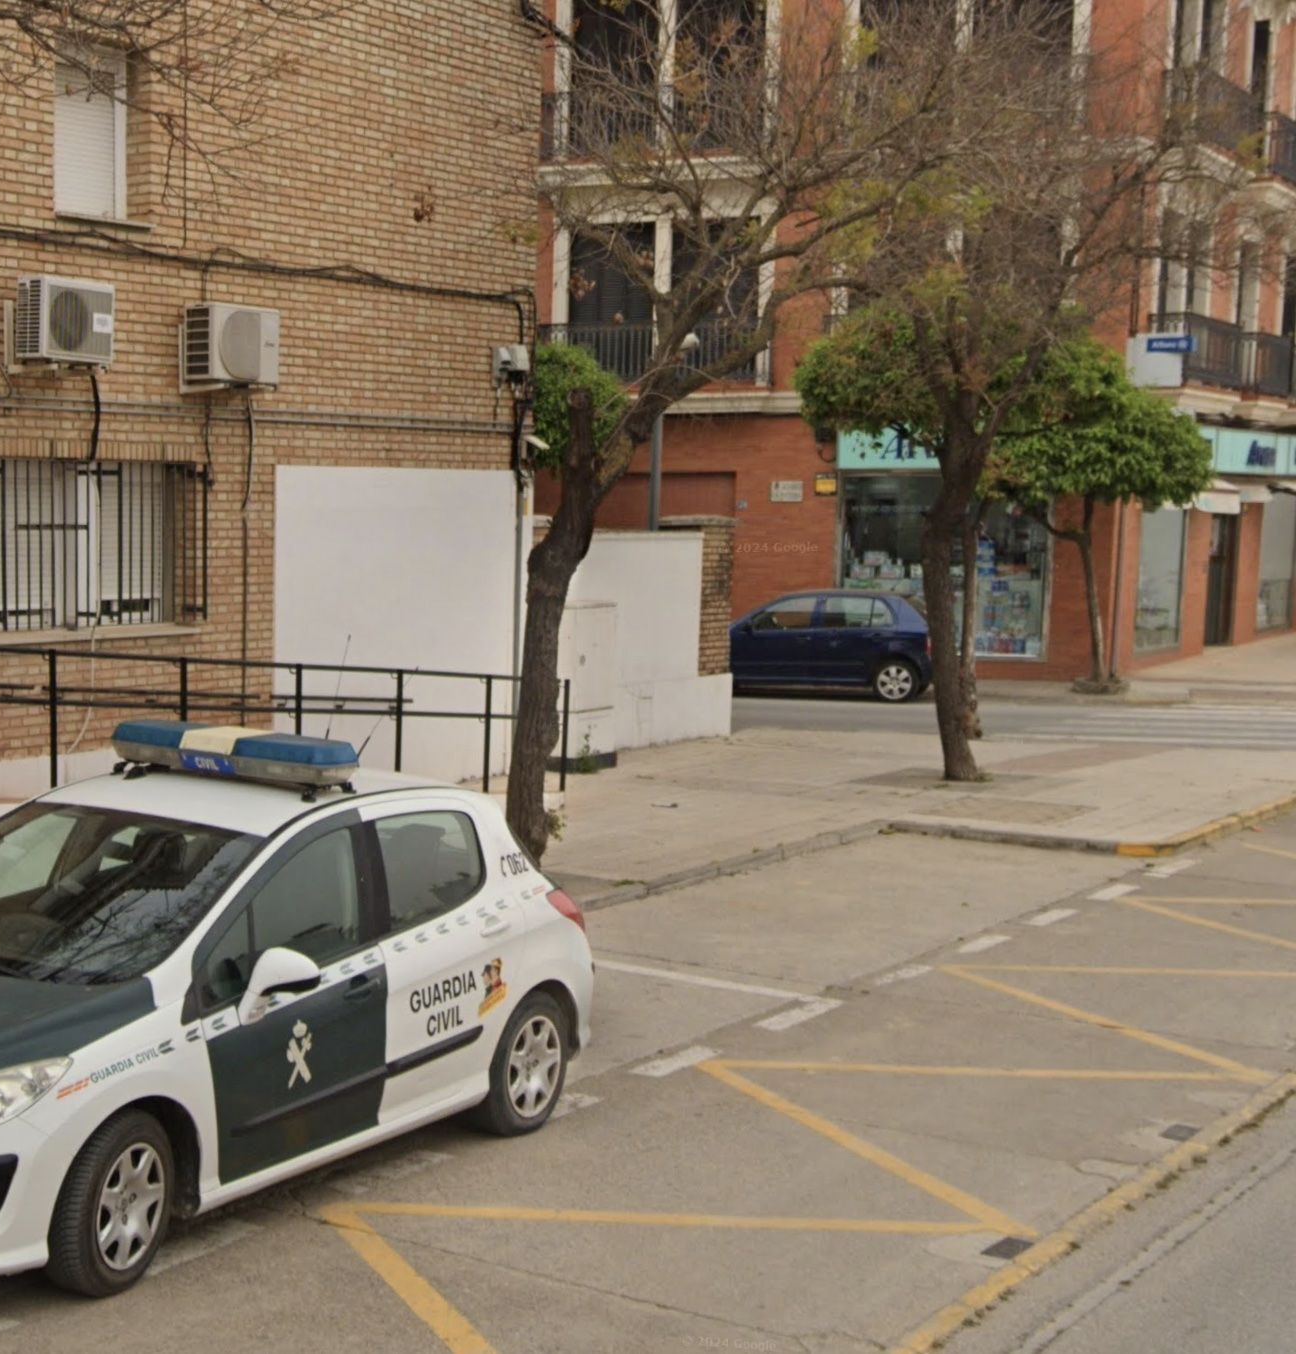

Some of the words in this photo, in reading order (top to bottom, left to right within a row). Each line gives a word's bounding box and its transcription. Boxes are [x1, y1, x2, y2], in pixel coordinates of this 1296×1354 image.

[194, 756, 220, 771] CIVIL
[506, 851, 529, 876] 062
[409, 970, 477, 1014] GUARDIA
[426, 1005, 464, 1038] CIVIL
[90, 1058, 135, 1084] GUARDIA
[135, 1047, 159, 1065] CIVIL
